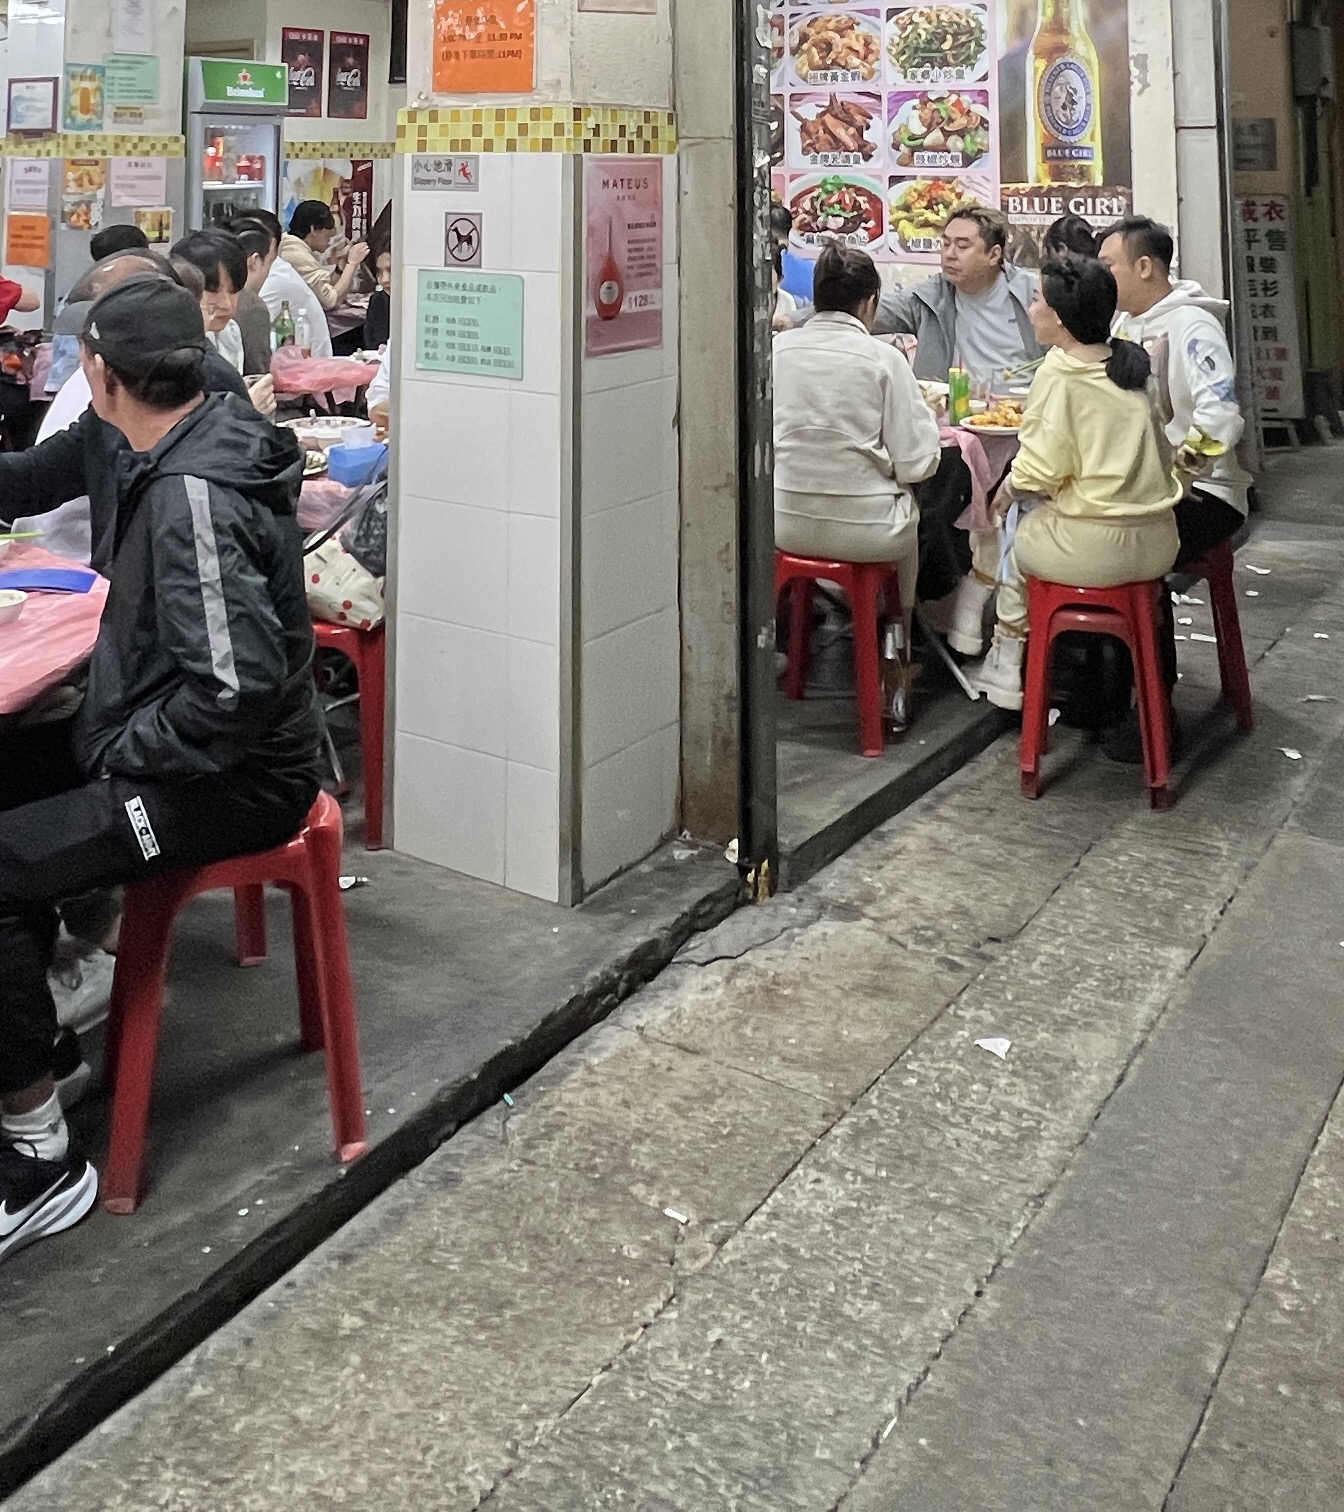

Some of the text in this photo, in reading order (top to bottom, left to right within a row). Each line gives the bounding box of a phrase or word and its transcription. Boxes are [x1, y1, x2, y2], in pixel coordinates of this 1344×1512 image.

[601, 177, 649, 190] MATEUS
[1008, 196, 1127, 216] BLUE GIRL
